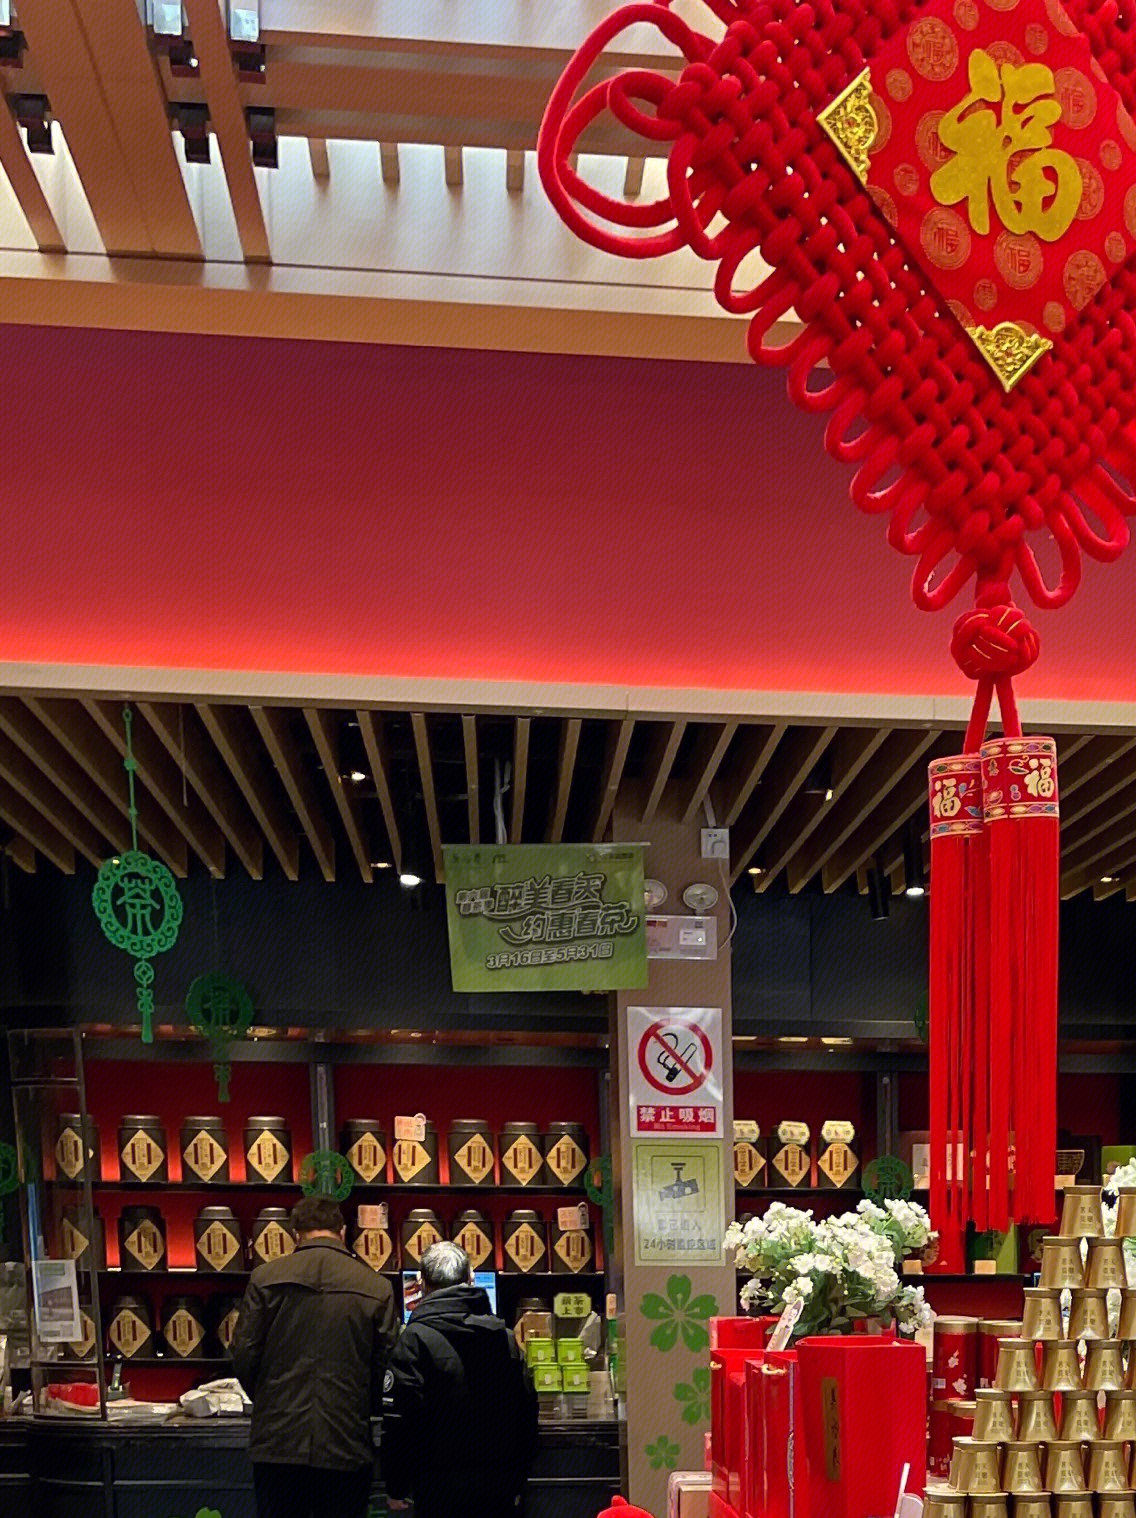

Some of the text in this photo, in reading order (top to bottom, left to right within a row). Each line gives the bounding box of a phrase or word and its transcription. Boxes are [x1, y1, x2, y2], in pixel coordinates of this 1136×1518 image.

[931, 49, 1083, 242] 福
[932, 778, 962, 818] 福
[1024, 758, 1055, 798] 福
[494, 872, 606, 914] 醉美春天
[499, 902, 640, 944] 约惠春茶
[486, 942, 614, 970] 3月16日至5月31日
[639, 1107, 715, 1123] 禁止吸烟
